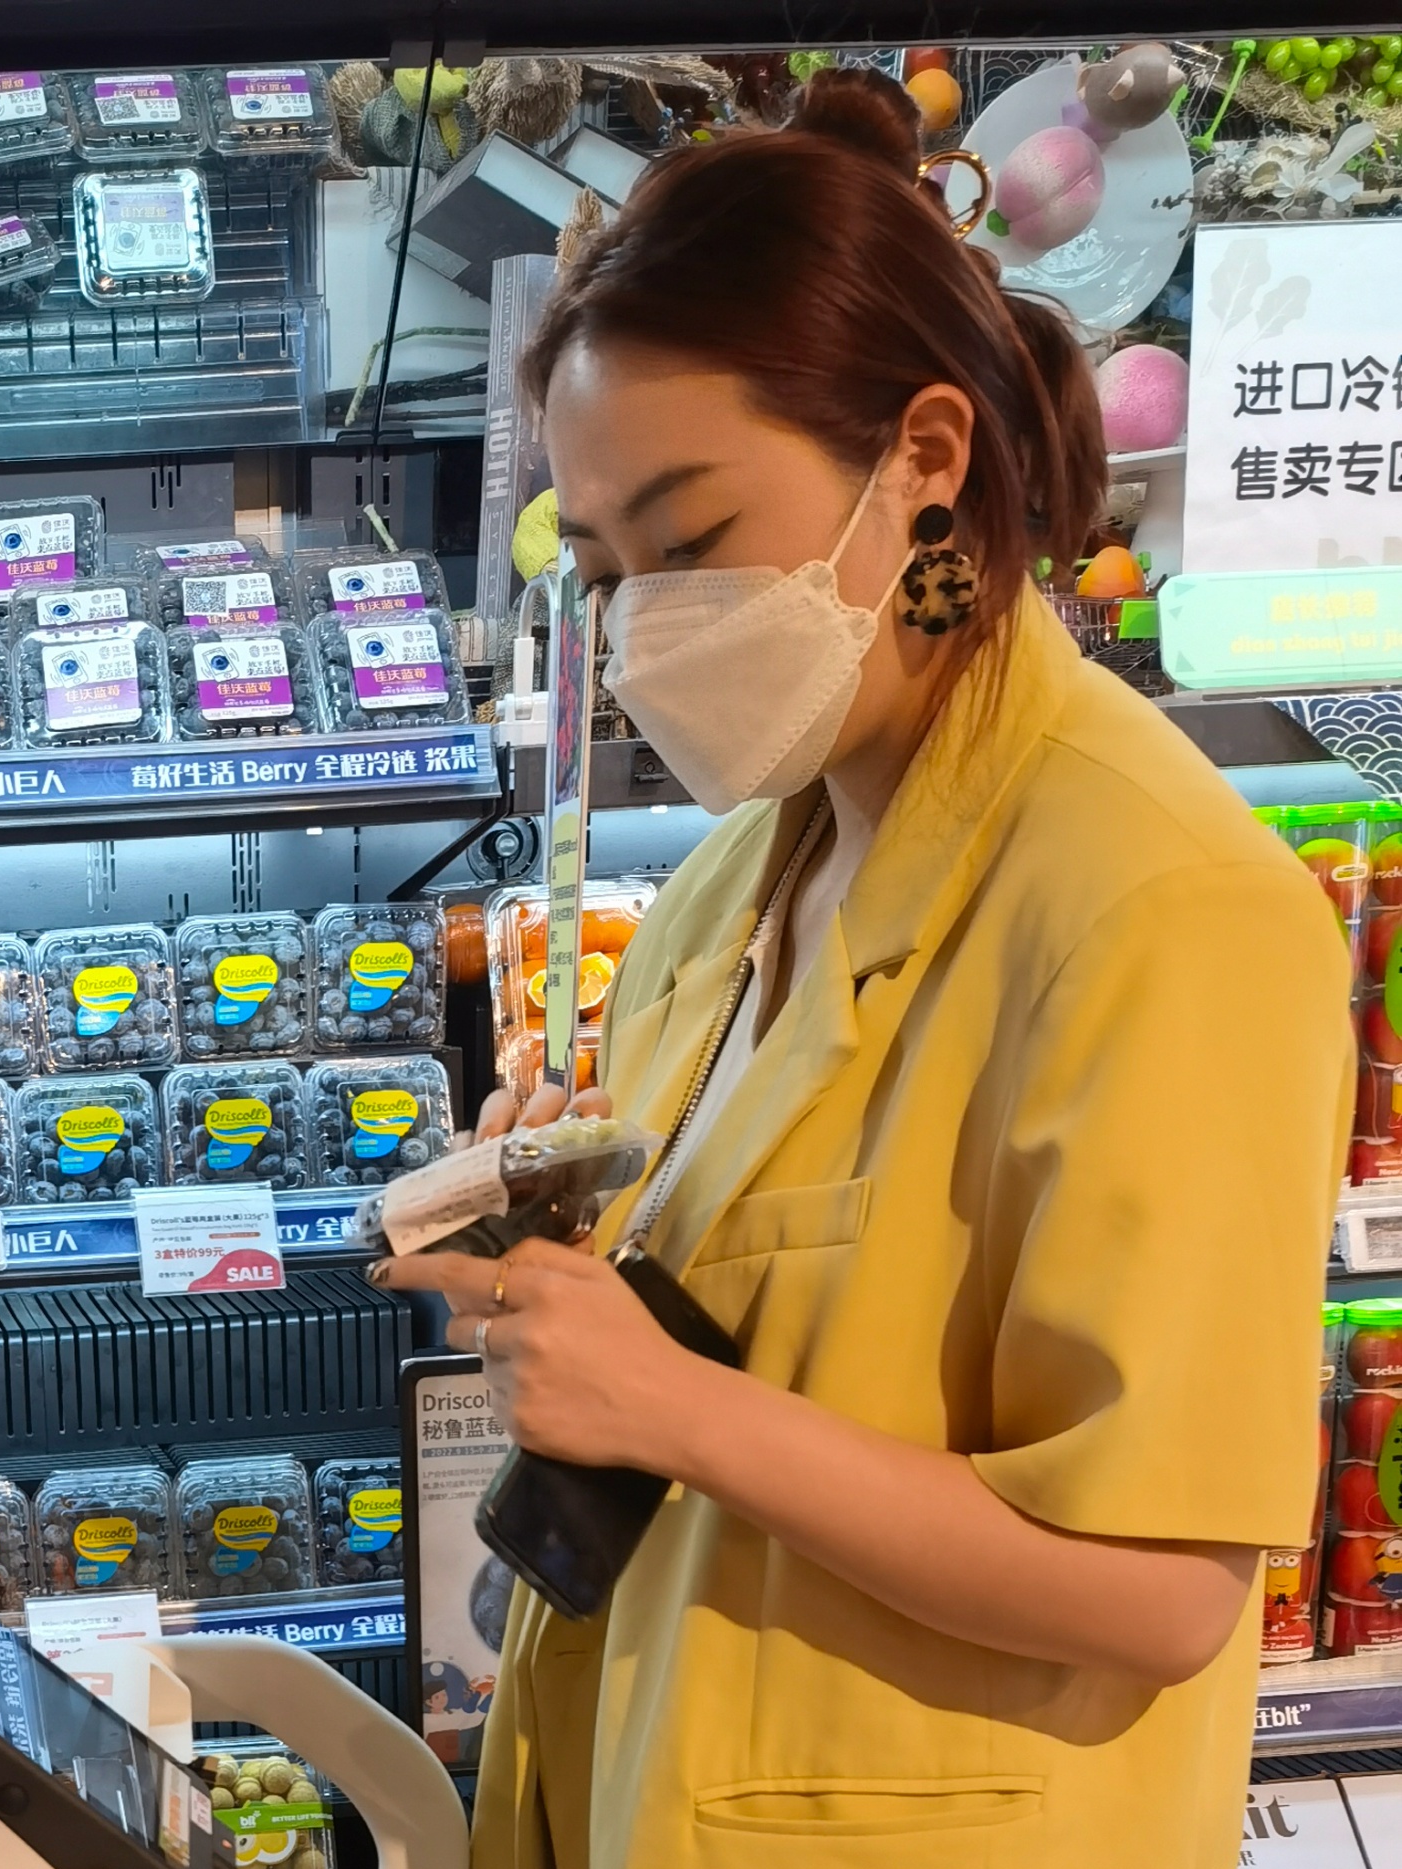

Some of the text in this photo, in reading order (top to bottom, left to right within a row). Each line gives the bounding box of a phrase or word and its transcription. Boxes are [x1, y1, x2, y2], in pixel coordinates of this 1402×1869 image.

[486, 407, 513, 501] HOTH
[1231, 441, 1402, 501] 售卖专
[132, 762, 234, 790] 莓好生活
[242, 759, 307, 785] Berry
[315, 750, 419, 780] 全程冷链
[355, 952, 410, 967] Driscoll's
[219, 965, 275, 981] Driscoll's
[78, 976, 135, 992] Driscoll's
[209, 1109, 267, 1124] Driscoll's
[355, 1100, 414, 1115] Driscoll's
[62, 1117, 121, 1132] Driscoll's
[226, 1266, 274, 1282] SALE
[423, 1389, 492, 1412] Driscol
[422, 1416, 506, 1441] 秘鲁蓝莓
[218, 1515, 275, 1533] Driscoll's
[79, 1525, 135, 1543] Driscoll's
[285, 1621, 345, 1644] Berry
[352, 1614, 404, 1637] 全程
